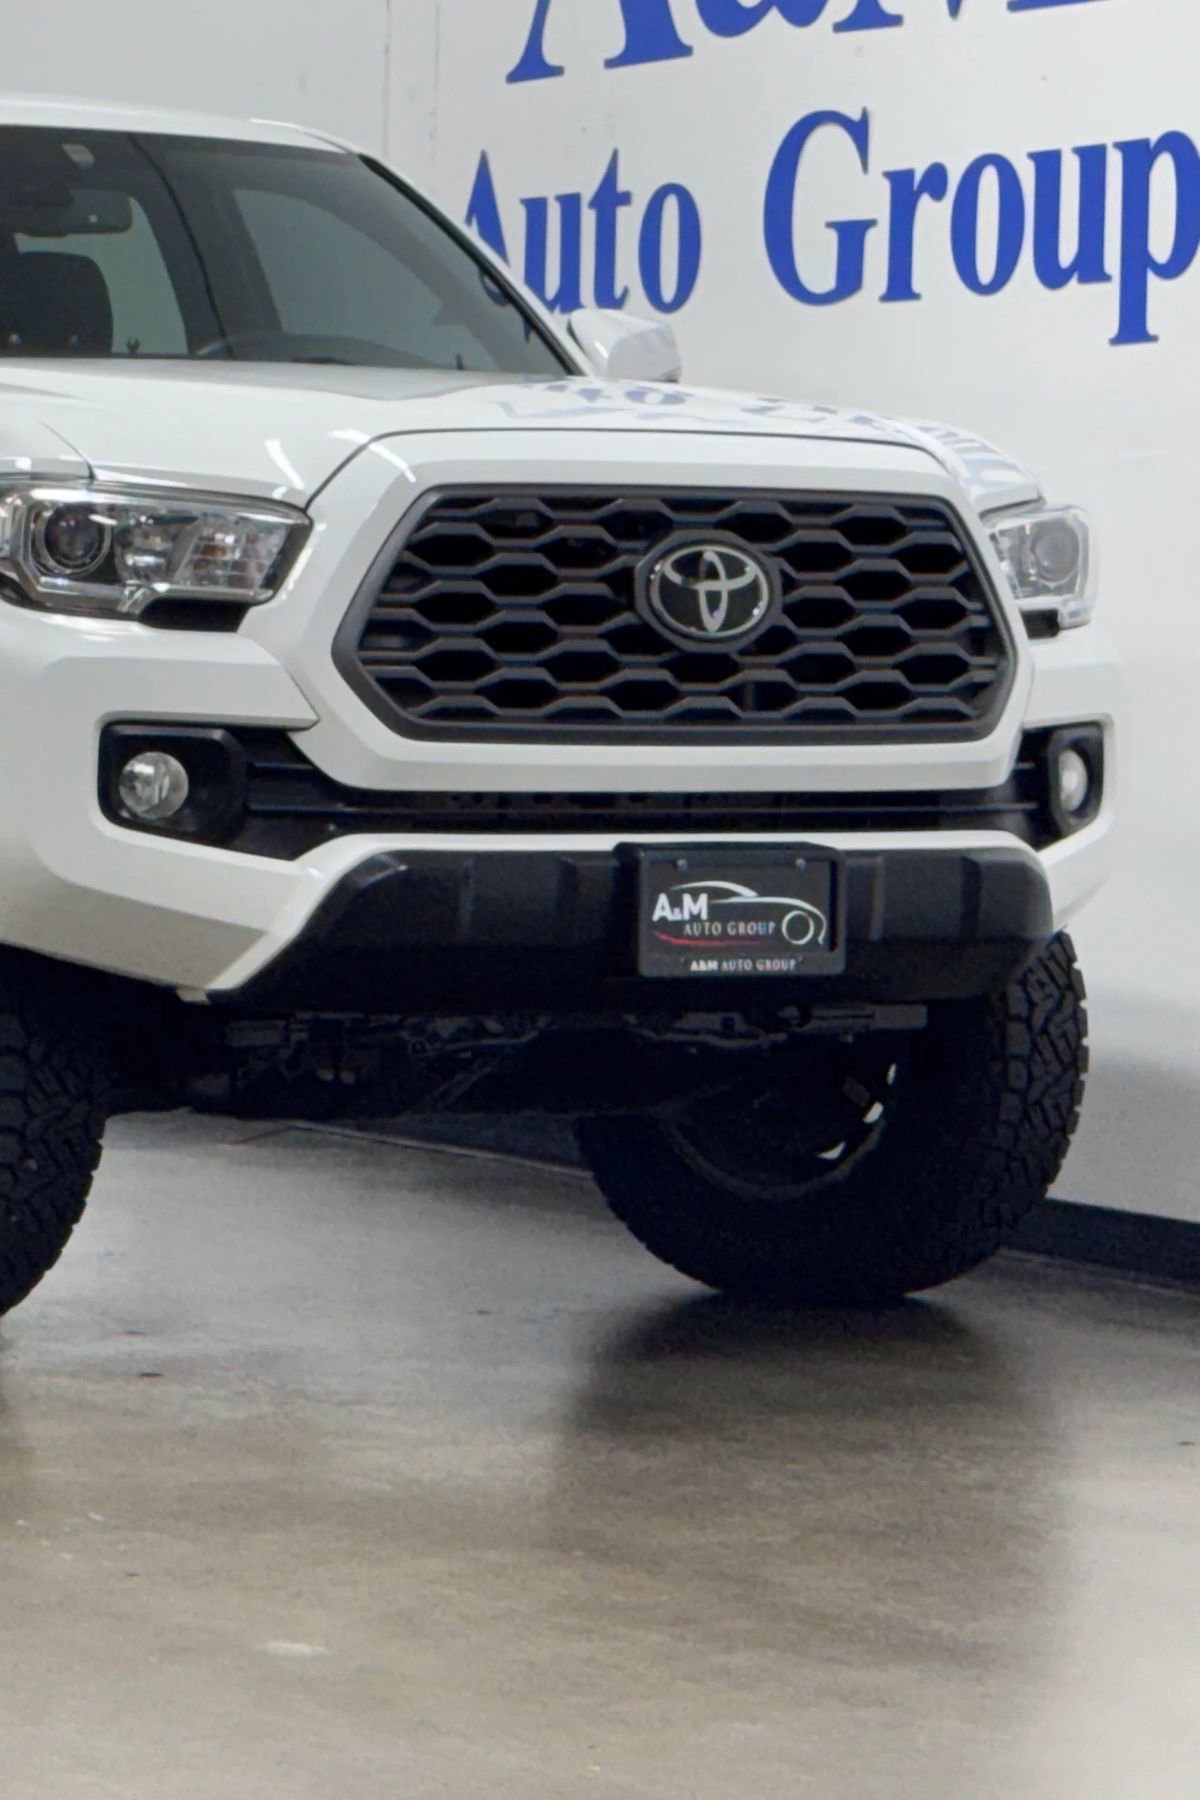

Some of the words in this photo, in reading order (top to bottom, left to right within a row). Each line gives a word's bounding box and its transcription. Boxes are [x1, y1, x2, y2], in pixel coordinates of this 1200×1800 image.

[763, 107, 1200, 346] Group
[652, 893, 709, 922] A&M
[683, 921, 722, 935] AUTO
[726, 920, 776, 935] GROUP
[721, 959, 752, 971] AUTO
[756, 958, 796, 971] GROUP
